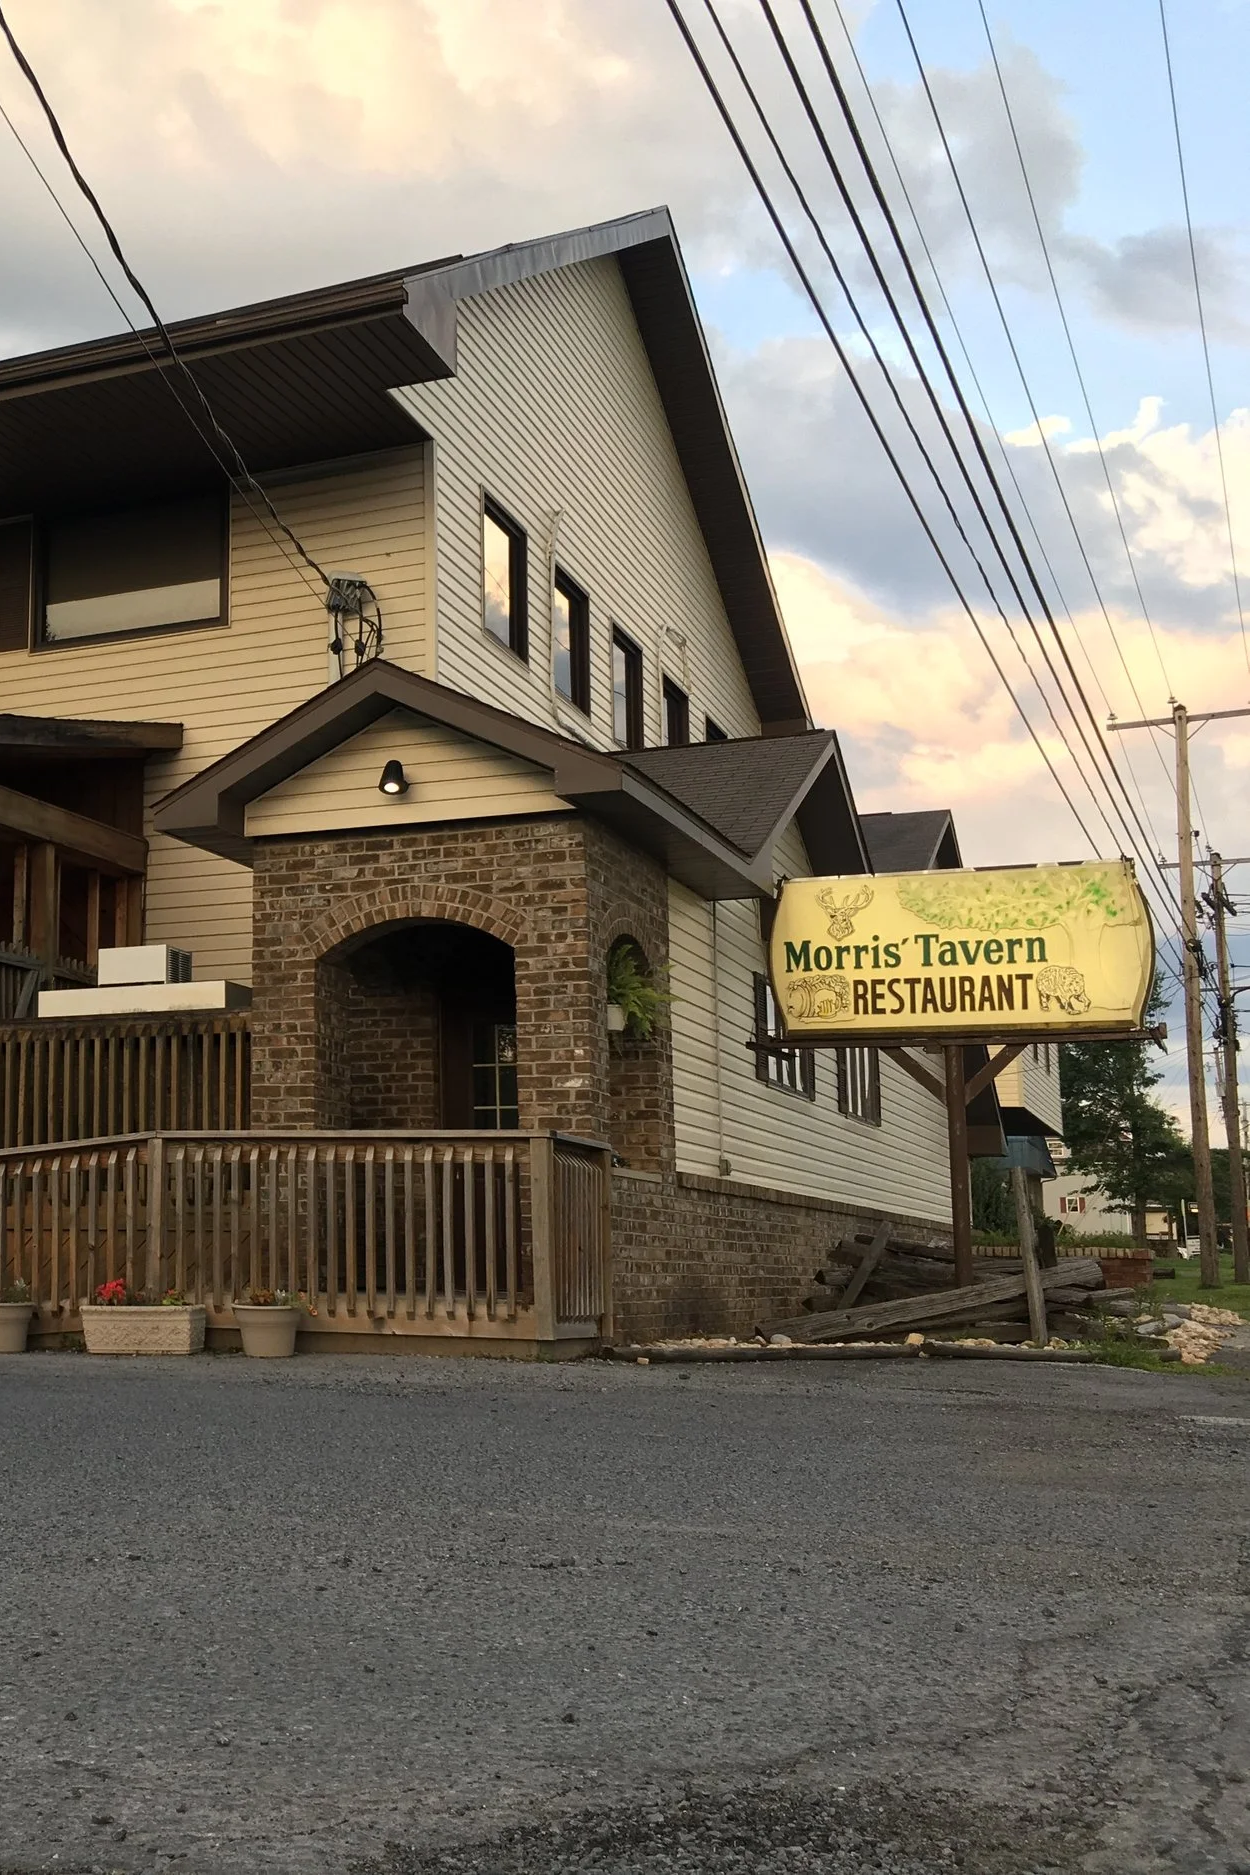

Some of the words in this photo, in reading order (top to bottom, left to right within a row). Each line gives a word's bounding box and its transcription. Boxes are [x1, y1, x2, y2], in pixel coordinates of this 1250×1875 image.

[784, 935, 909, 973] Morris'
[914, 934, 1048, 967] Tavern
[853, 973, 1033, 1015] RESTAURANT
